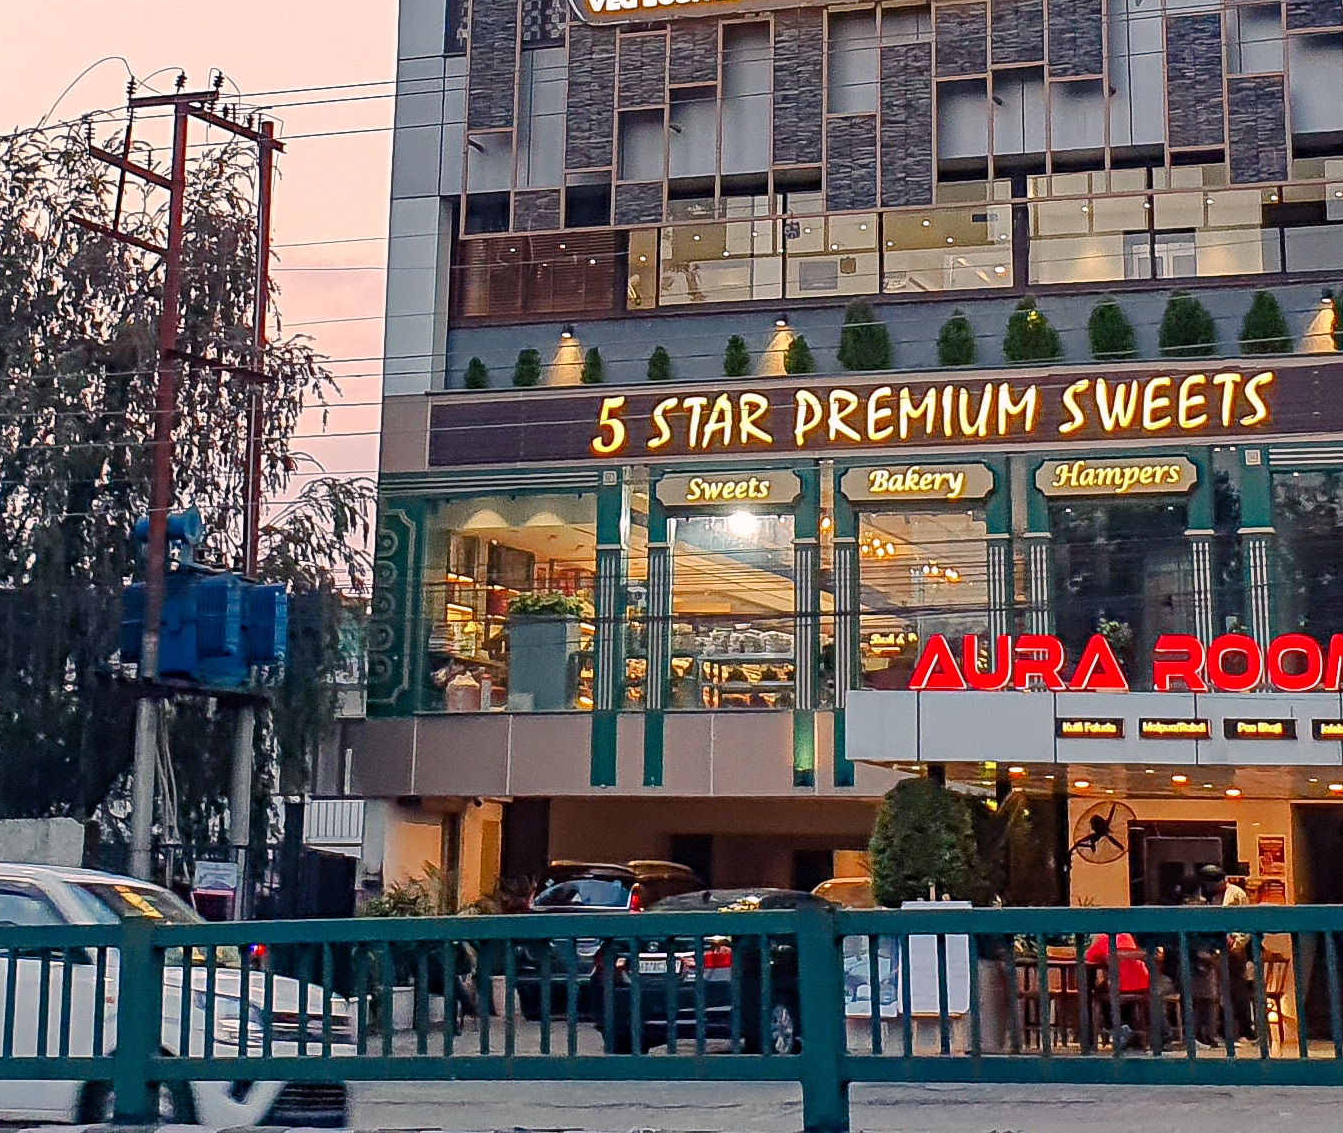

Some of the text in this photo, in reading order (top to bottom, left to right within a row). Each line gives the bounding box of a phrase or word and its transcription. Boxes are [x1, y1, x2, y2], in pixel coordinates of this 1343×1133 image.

[591, 371, 1274, 454] 5 STAR PREMIUM SWEETS
[686, 477, 770, 501] Sweets
[868, 466, 964, 498] Bakery
[1052, 460, 1180, 494] Hampers
[908, 633, 1129, 691] AURA
